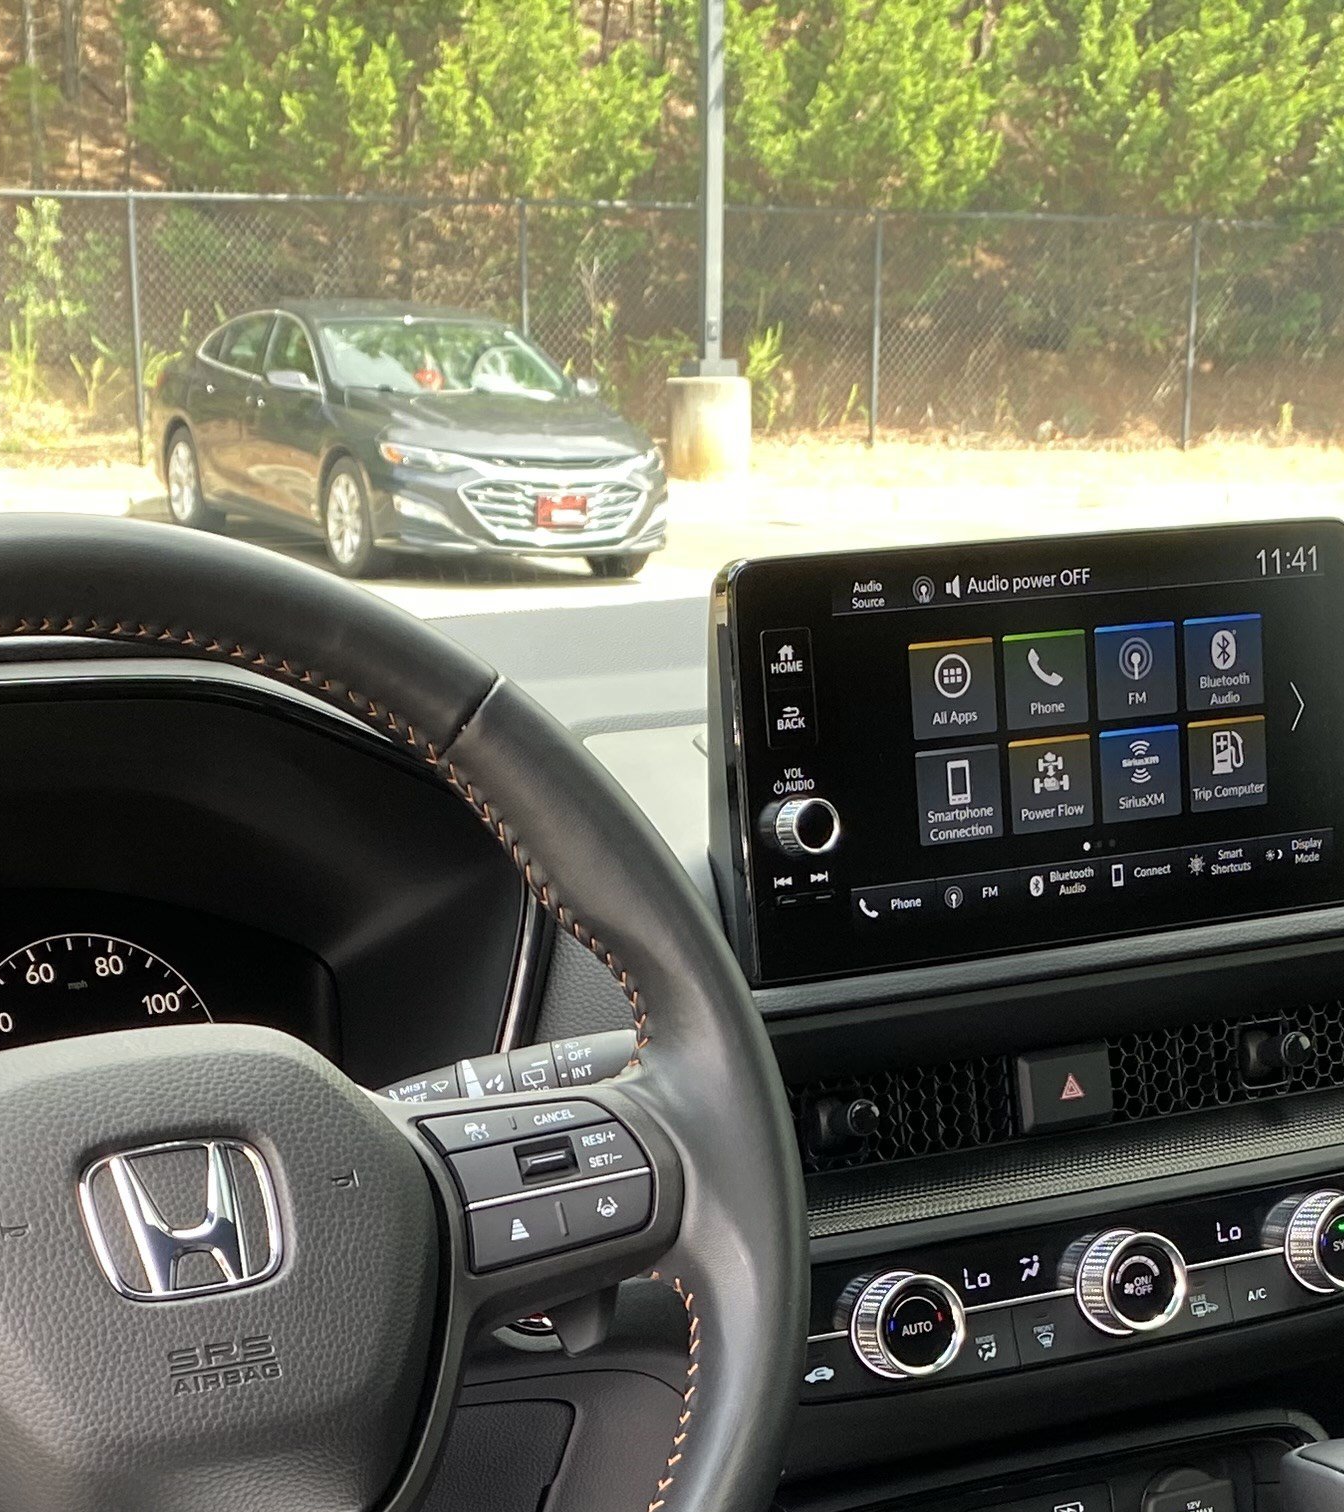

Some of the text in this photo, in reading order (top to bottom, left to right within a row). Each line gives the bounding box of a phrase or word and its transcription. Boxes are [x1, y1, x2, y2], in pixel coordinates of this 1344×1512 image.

[1256, 545, 1318, 576] 11:41
[852, 581, 883, 594] Audio
[966, 567, 1092, 594] Audio power OFF
[851, 596, 885, 609] Source
[770, 660, 804, 674] HOME
[1199, 672, 1251, 689] Bluetooth
[1128, 691, 1147, 705] FM
[1209, 691, 1241, 706] Audio
[1030, 700, 1066, 715] Phone
[777, 717, 806, 731] BACK
[932, 709, 978, 726] All Apps
[784, 768, 805, 780] VOL
[785, 779, 815, 793] AUDIO
[1192, 781, 1266, 802] Trip Computer
[1118, 792, 1166, 810] SiriusXM
[927, 806, 994, 824] Smartphone
[1021, 803, 1085, 822] Power Flow
[929, 825, 994, 842] Connection
[1291, 838, 1323, 853] Display
[1217, 848, 1244, 861] Smart
[1294, 851, 1321, 865] Mode
[1049, 866, 1095, 882] Bluetooth
[1133, 863, 1172, 878] Connect
[1210, 861, 1252, 876] Shortcuts
[982, 886, 999, 899] FM
[1058, 882, 1087, 896] Audio
[890, 896, 922, 911] Phone
[94, 954, 124, 977] 80
[25, 963, 55, 985] 60
[141, 991, 181, 1016] 100
[567, 1048, 593, 1061] OFF
[571, 1064, 593, 1079] INT
[399, 1080, 428, 1096] MIST
[533, 1109, 575, 1126] CANCEL
[581, 1131, 617, 1147] RES/+
[1215, 1221, 1242, 1243] Lo
[962, 1267, 991, 1290] Lo
[1133, 1274, 1153, 1287] ON/
[1134, 1283, 1154, 1297] OFF
[1247, 1287, 1267, 1301] A/C
[901, 1320, 933, 1337] AUTO
[167, 1334, 276, 1372] SRS
[173, 1362, 284, 1397] AIRBAG
[1186, 1500, 1201, 1510] 12V
